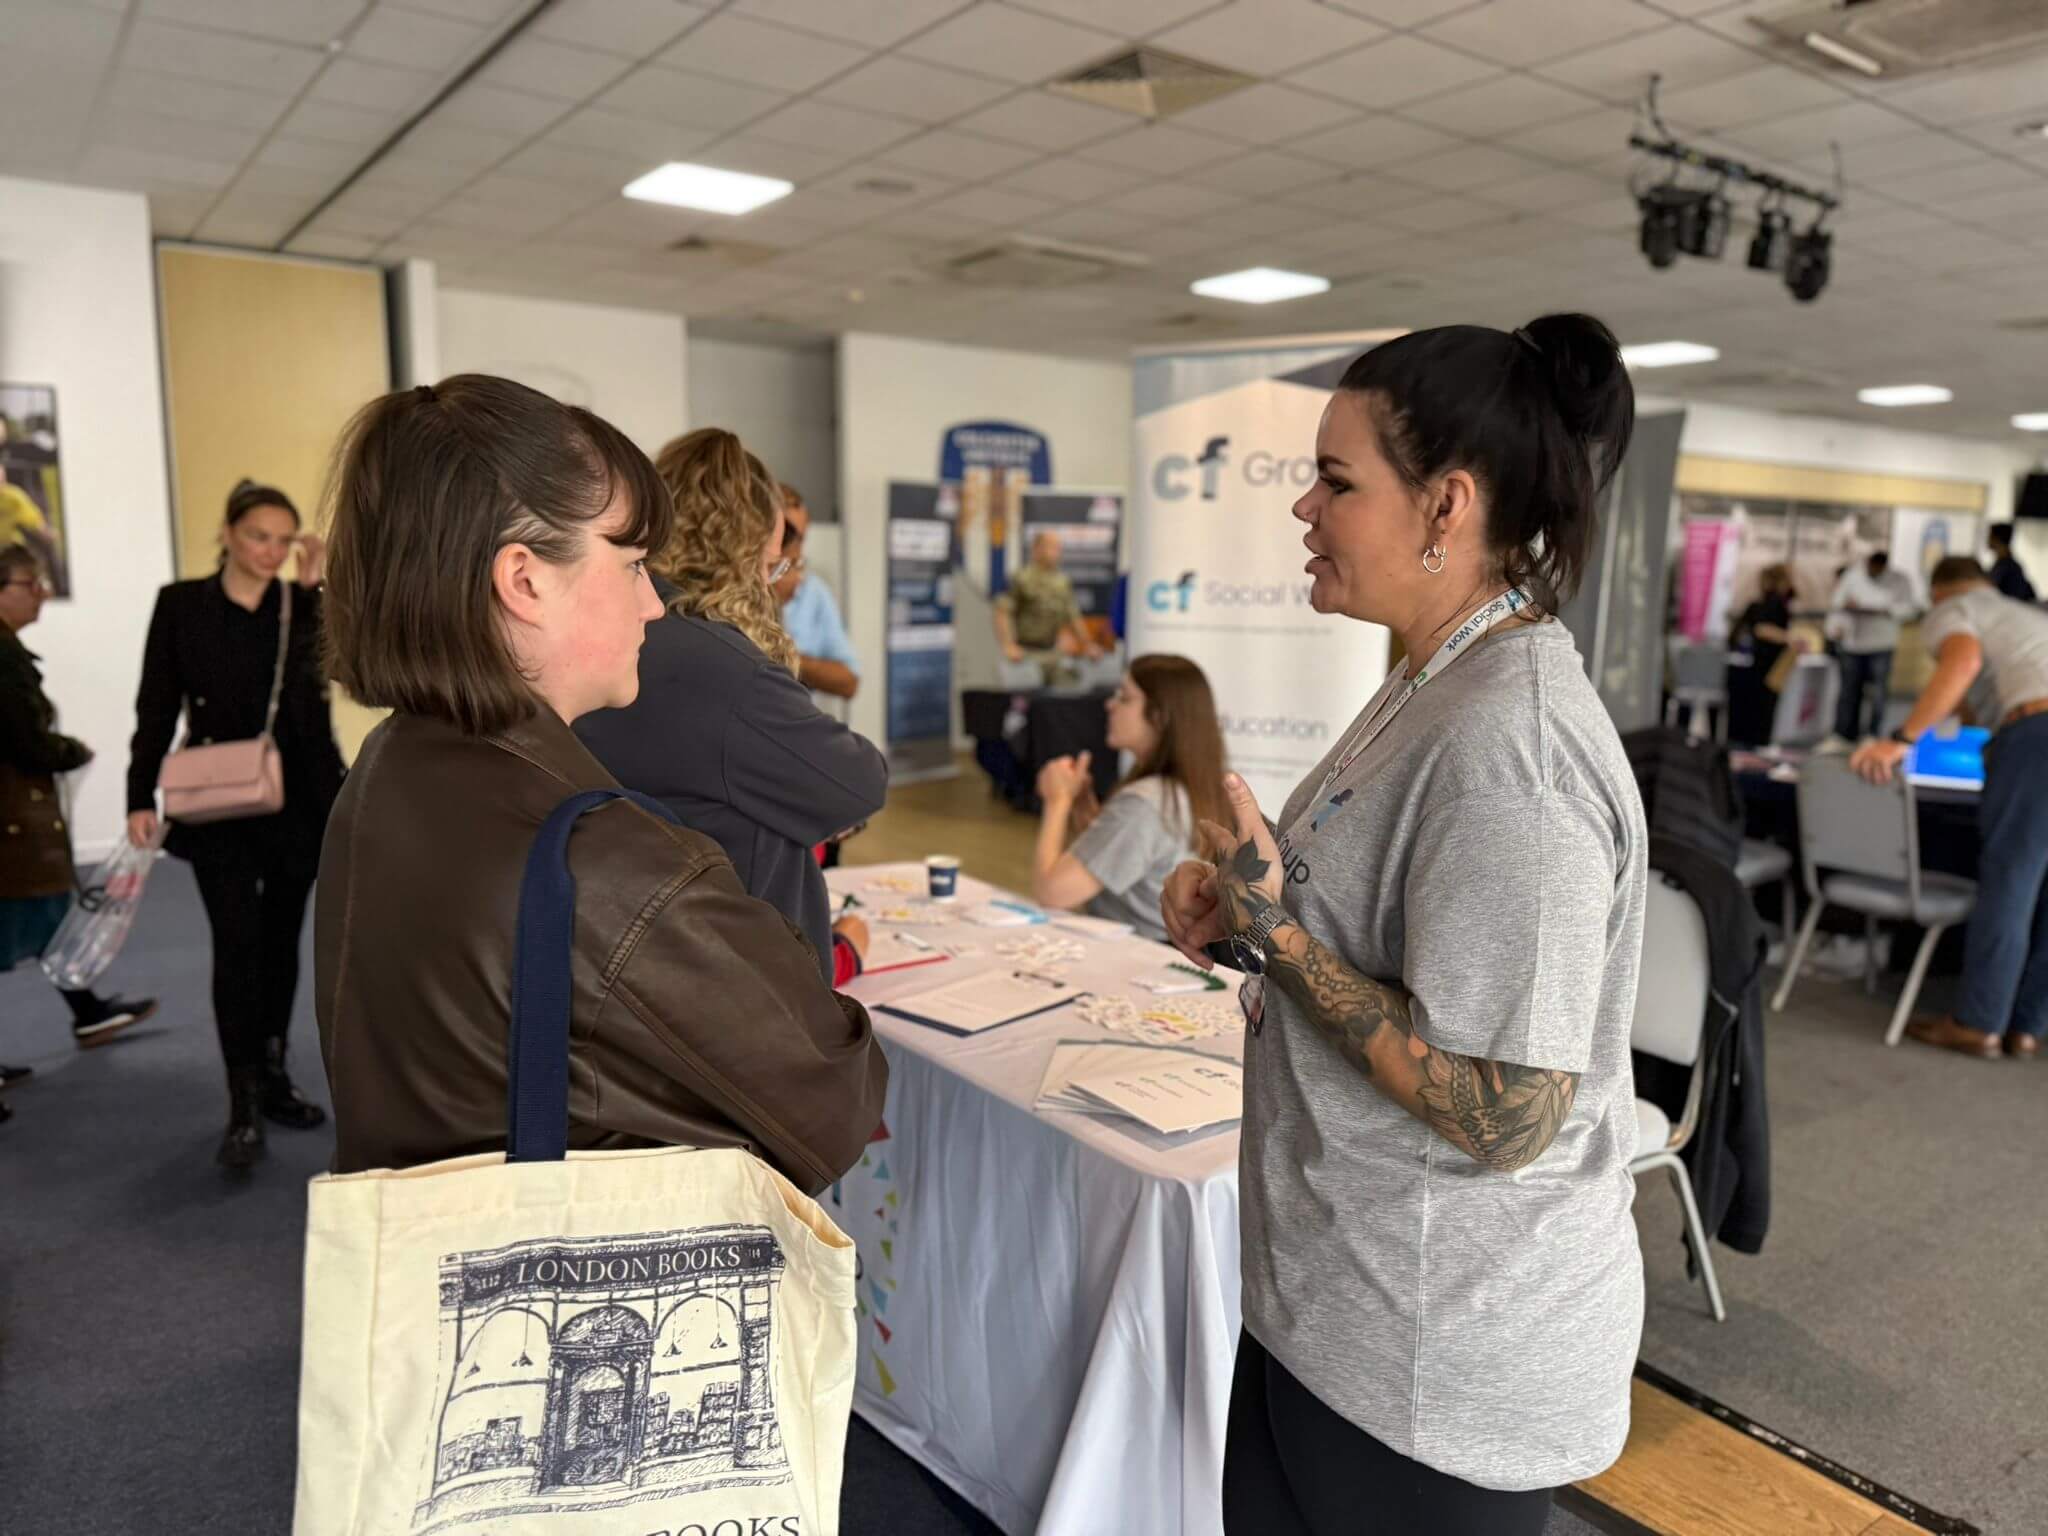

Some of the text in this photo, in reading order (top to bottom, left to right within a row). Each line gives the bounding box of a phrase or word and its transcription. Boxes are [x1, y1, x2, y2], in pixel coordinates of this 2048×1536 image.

[1153, 436, 1318, 499] cf Gro
[1146, 571, 1196, 612] cf
[1206, 579, 1282, 606] Social
[1472, 600, 1505, 628] Social
[1445, 624, 1474, 652] Work
[518, 1257, 650, 1283] LONDON
[658, 1245, 740, 1275] BOOKS
[647, 1515, 800, 1536] OOKS
